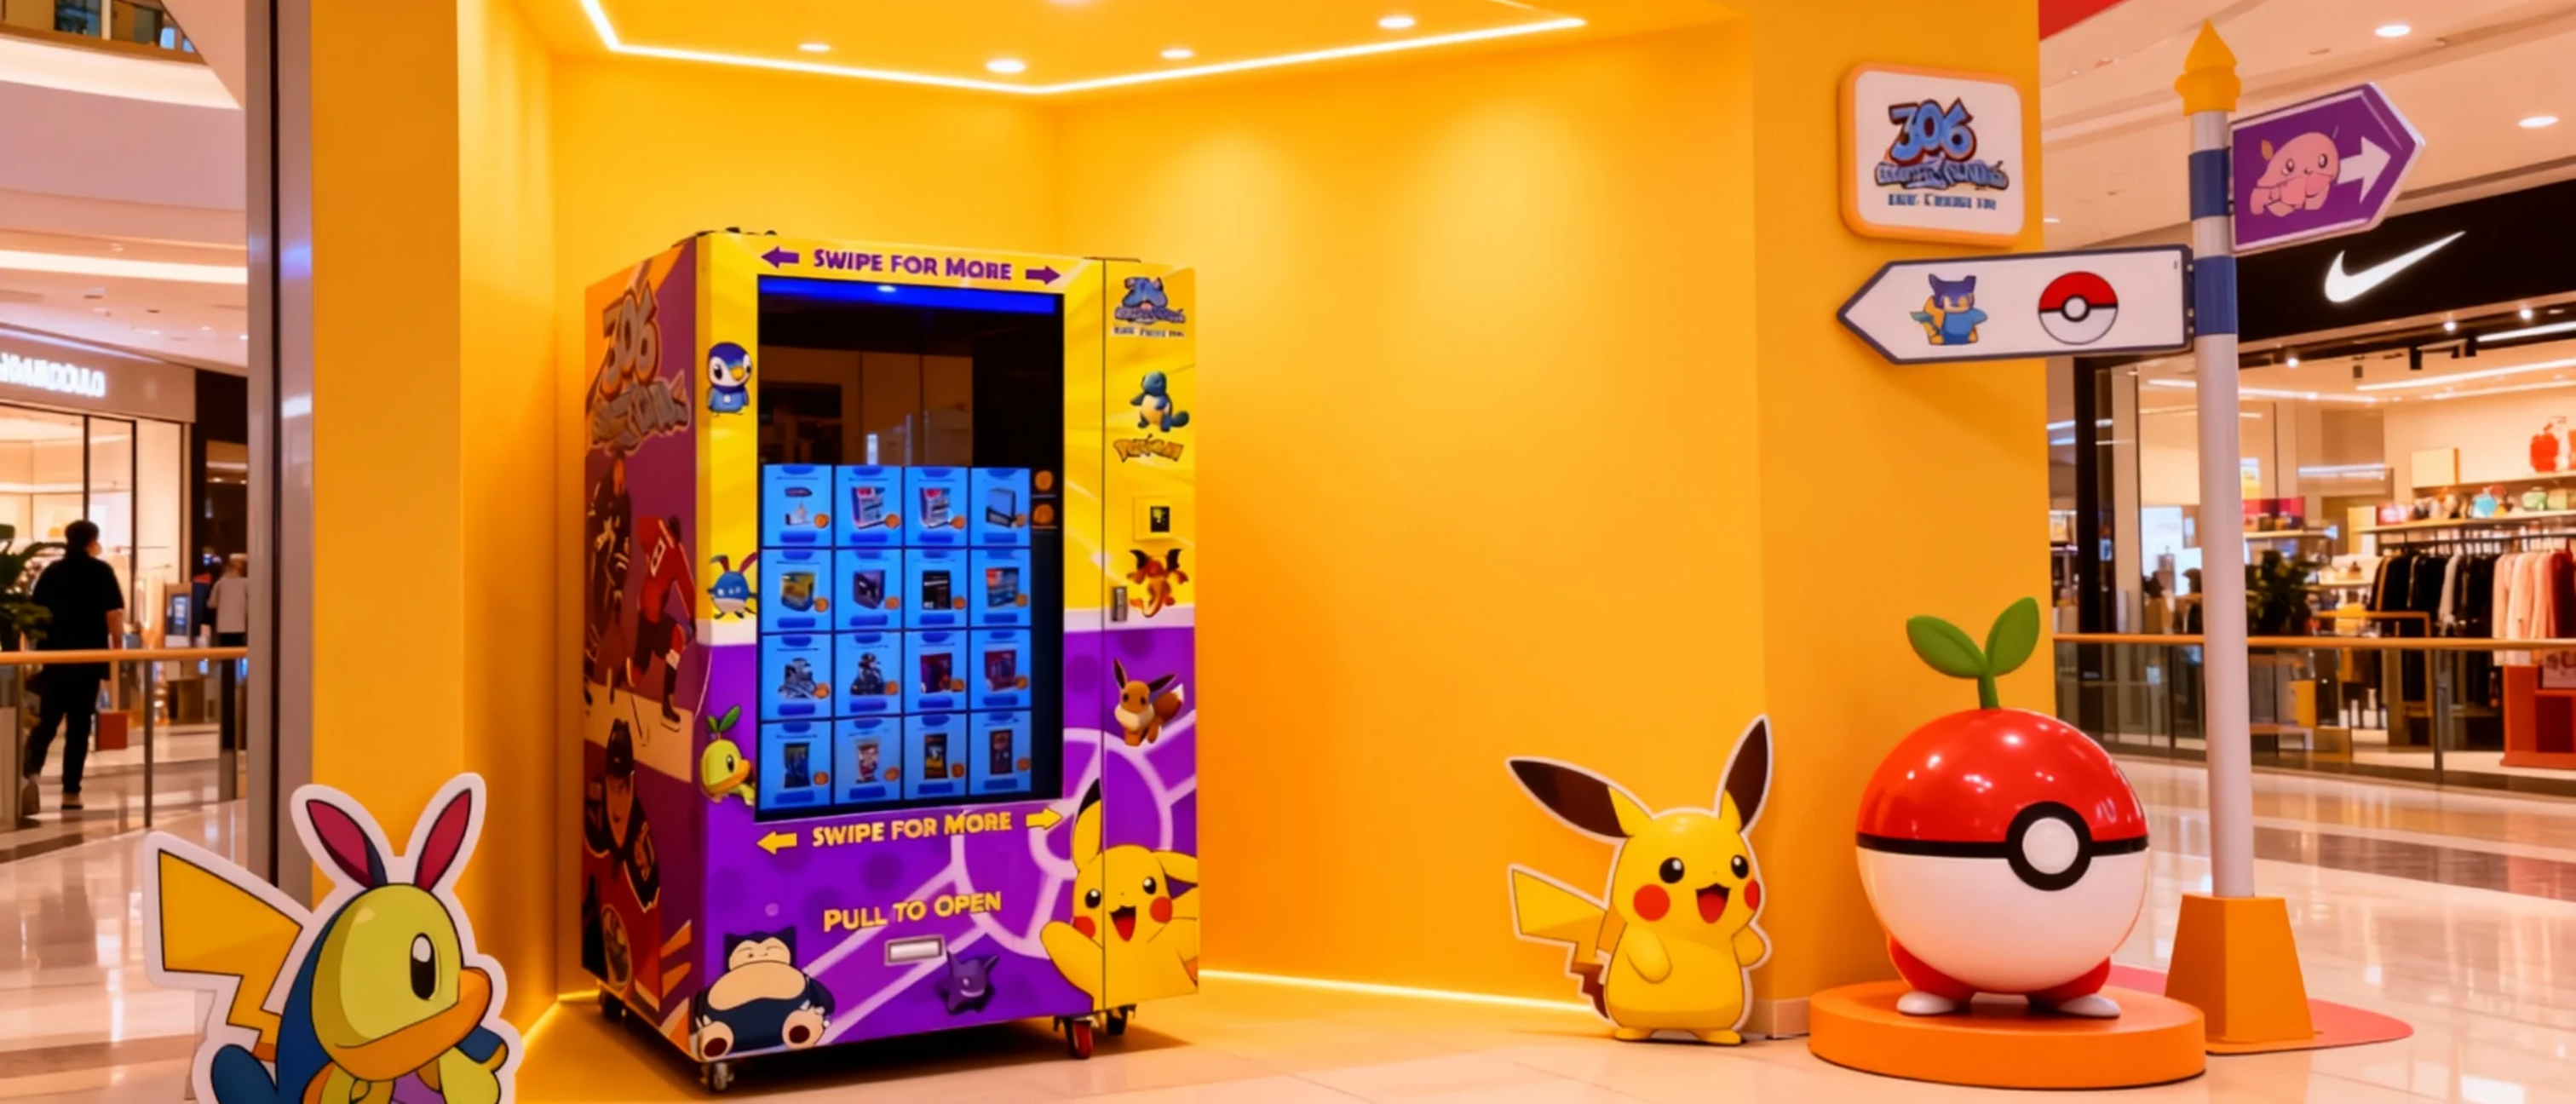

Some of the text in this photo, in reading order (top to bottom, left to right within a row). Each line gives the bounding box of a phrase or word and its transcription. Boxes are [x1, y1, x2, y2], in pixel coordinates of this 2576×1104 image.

[1888, 96, 1977, 166] 306
[813, 249, 1013, 280] SWIPE FOR MORE
[599, 280, 660, 402] 306
[812, 811, 1013, 848] SWIPE FOR MORE
[822, 890, 1002, 933] PULL TO OPEN
